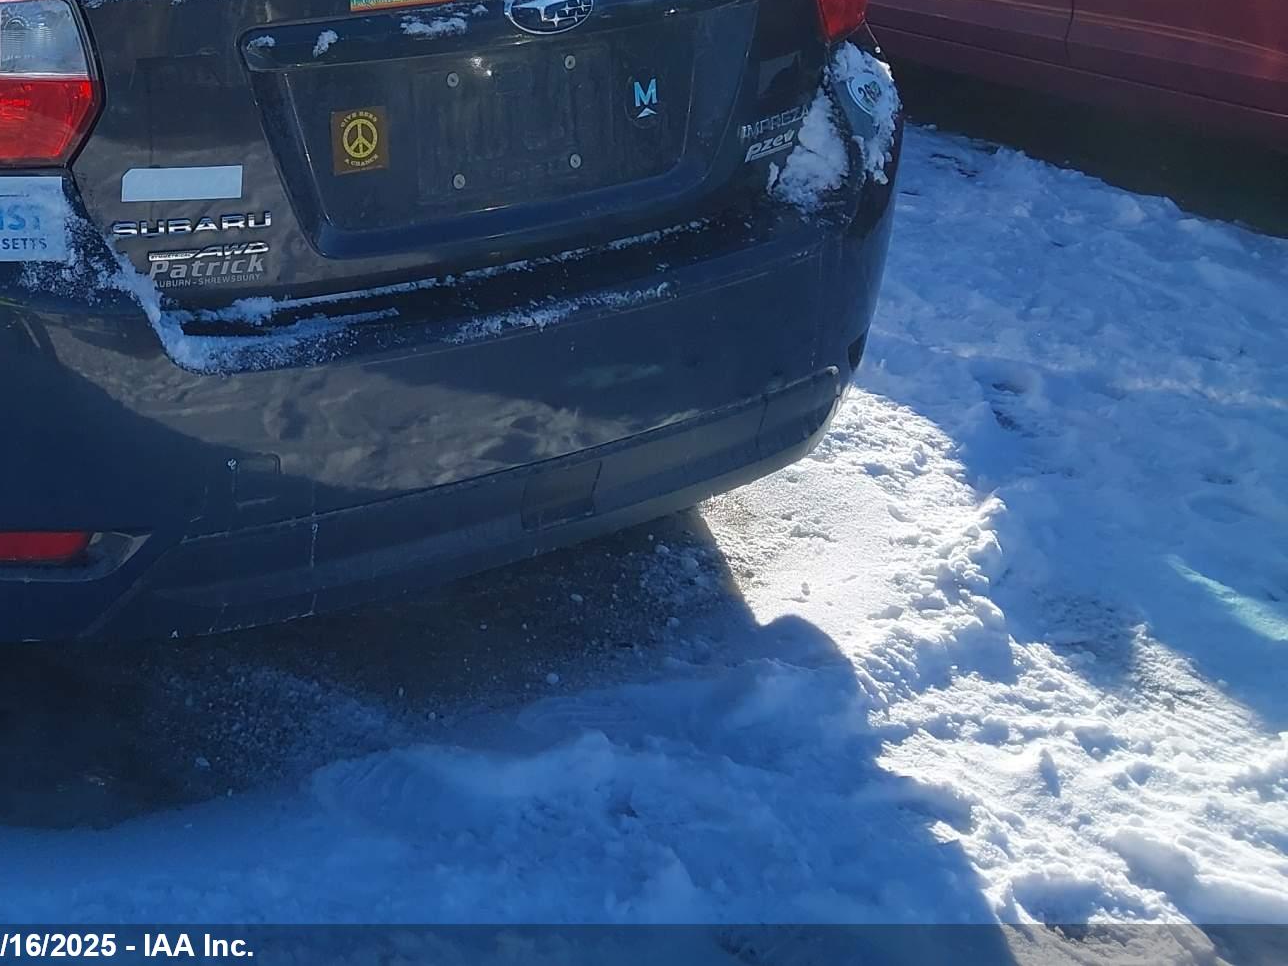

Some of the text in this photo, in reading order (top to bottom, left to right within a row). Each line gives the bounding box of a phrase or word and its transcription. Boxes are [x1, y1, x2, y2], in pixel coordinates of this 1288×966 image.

[634, 79, 657, 106] M
[112, 211, 273, 239] SUBARU
[195, 242, 270, 259] AWD
[150, 253, 265, 280] Patrick
[199, 273, 261, 286] SHREWSBURY
